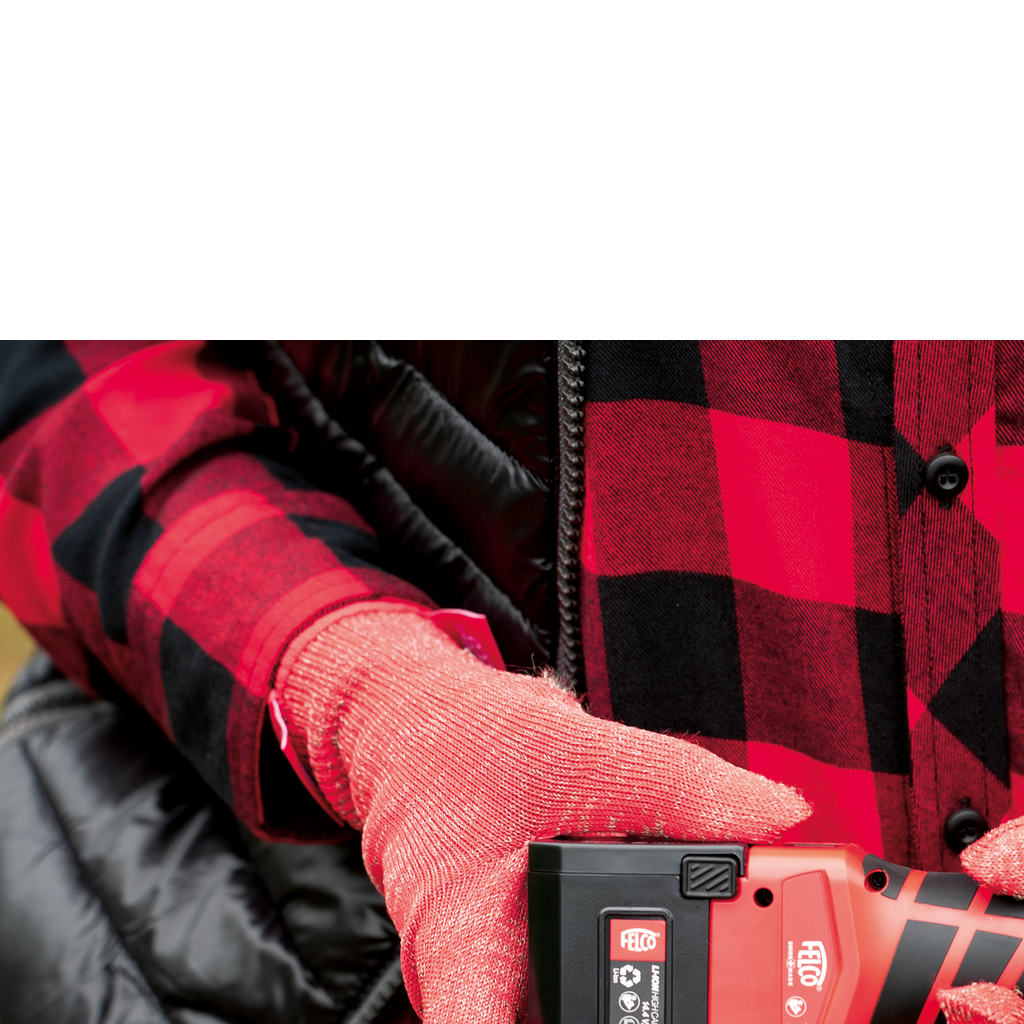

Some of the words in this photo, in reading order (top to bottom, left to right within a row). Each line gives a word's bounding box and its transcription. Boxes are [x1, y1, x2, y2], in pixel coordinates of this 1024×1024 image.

[620, 928, 657, 952] FELCO
[797, 941, 827, 987] FELCO
[641, 1001, 650, 1018] 14.4
[651, 991, 660, 1011] HIGH
